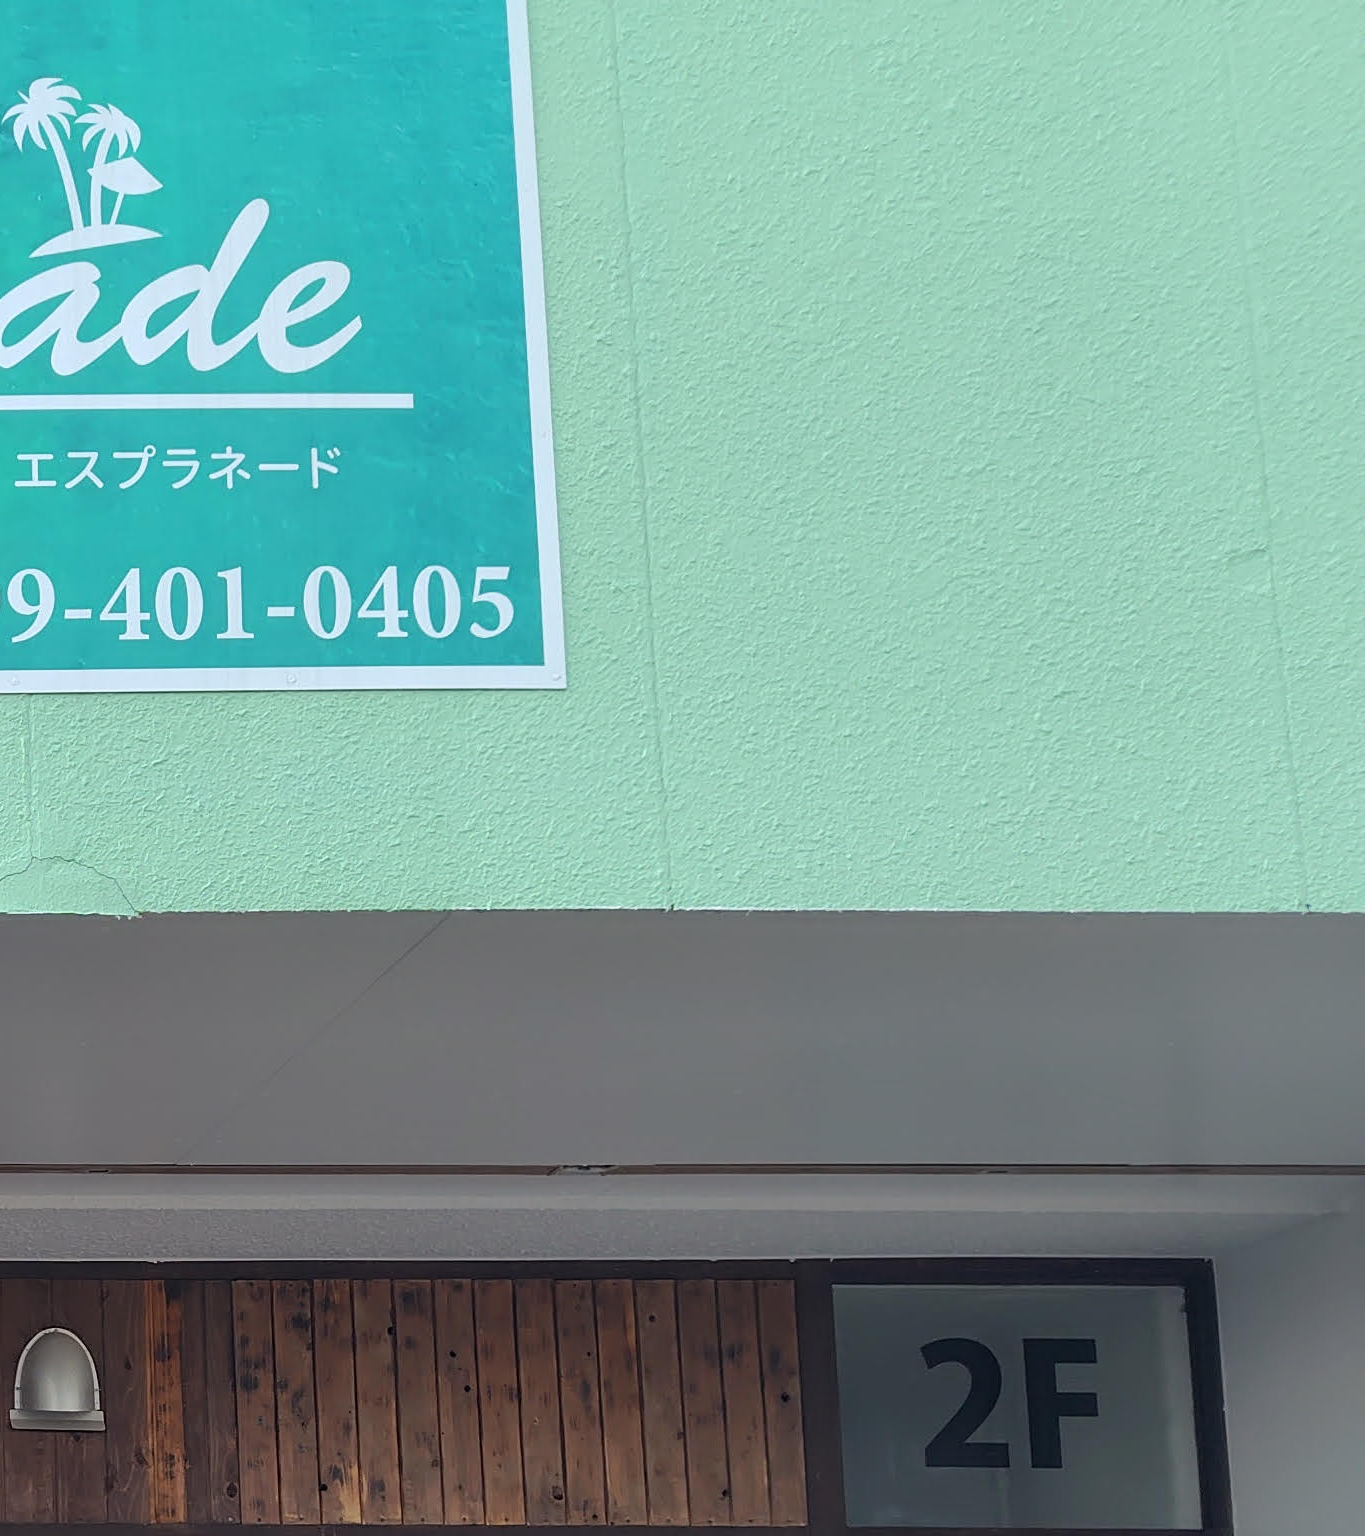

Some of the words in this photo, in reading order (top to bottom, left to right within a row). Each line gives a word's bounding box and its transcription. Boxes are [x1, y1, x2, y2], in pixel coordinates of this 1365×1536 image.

[15, 447, 342, 493] エスプラネード
[920, 1337, 1099, 1469] 2F
